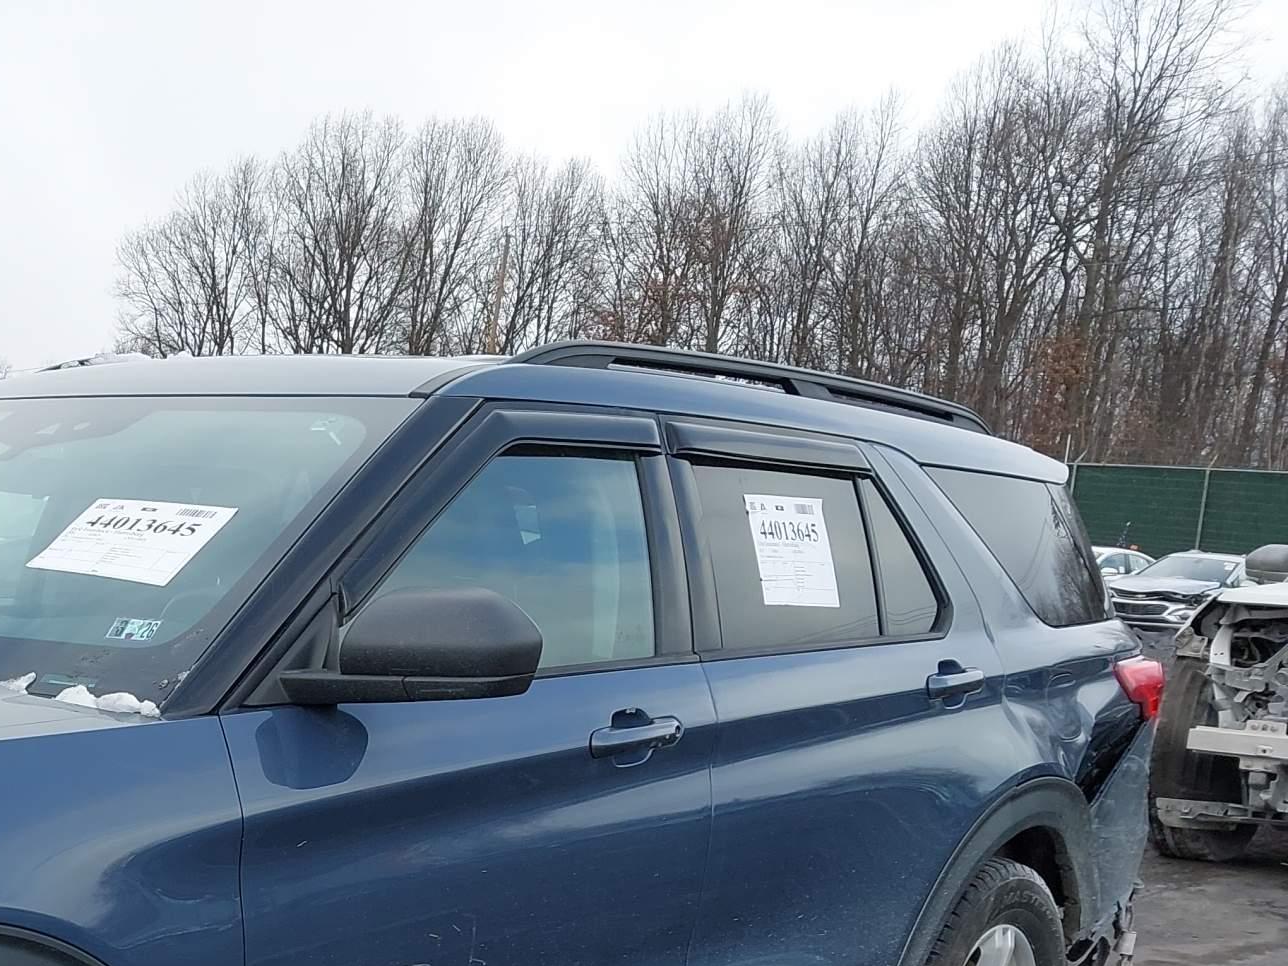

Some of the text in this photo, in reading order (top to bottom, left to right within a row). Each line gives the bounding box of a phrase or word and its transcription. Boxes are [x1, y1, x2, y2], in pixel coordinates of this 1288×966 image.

[85, 514, 202, 537] 44013645
[759, 519, 819, 542] 44013645
[140, 622, 158, 638] 26
